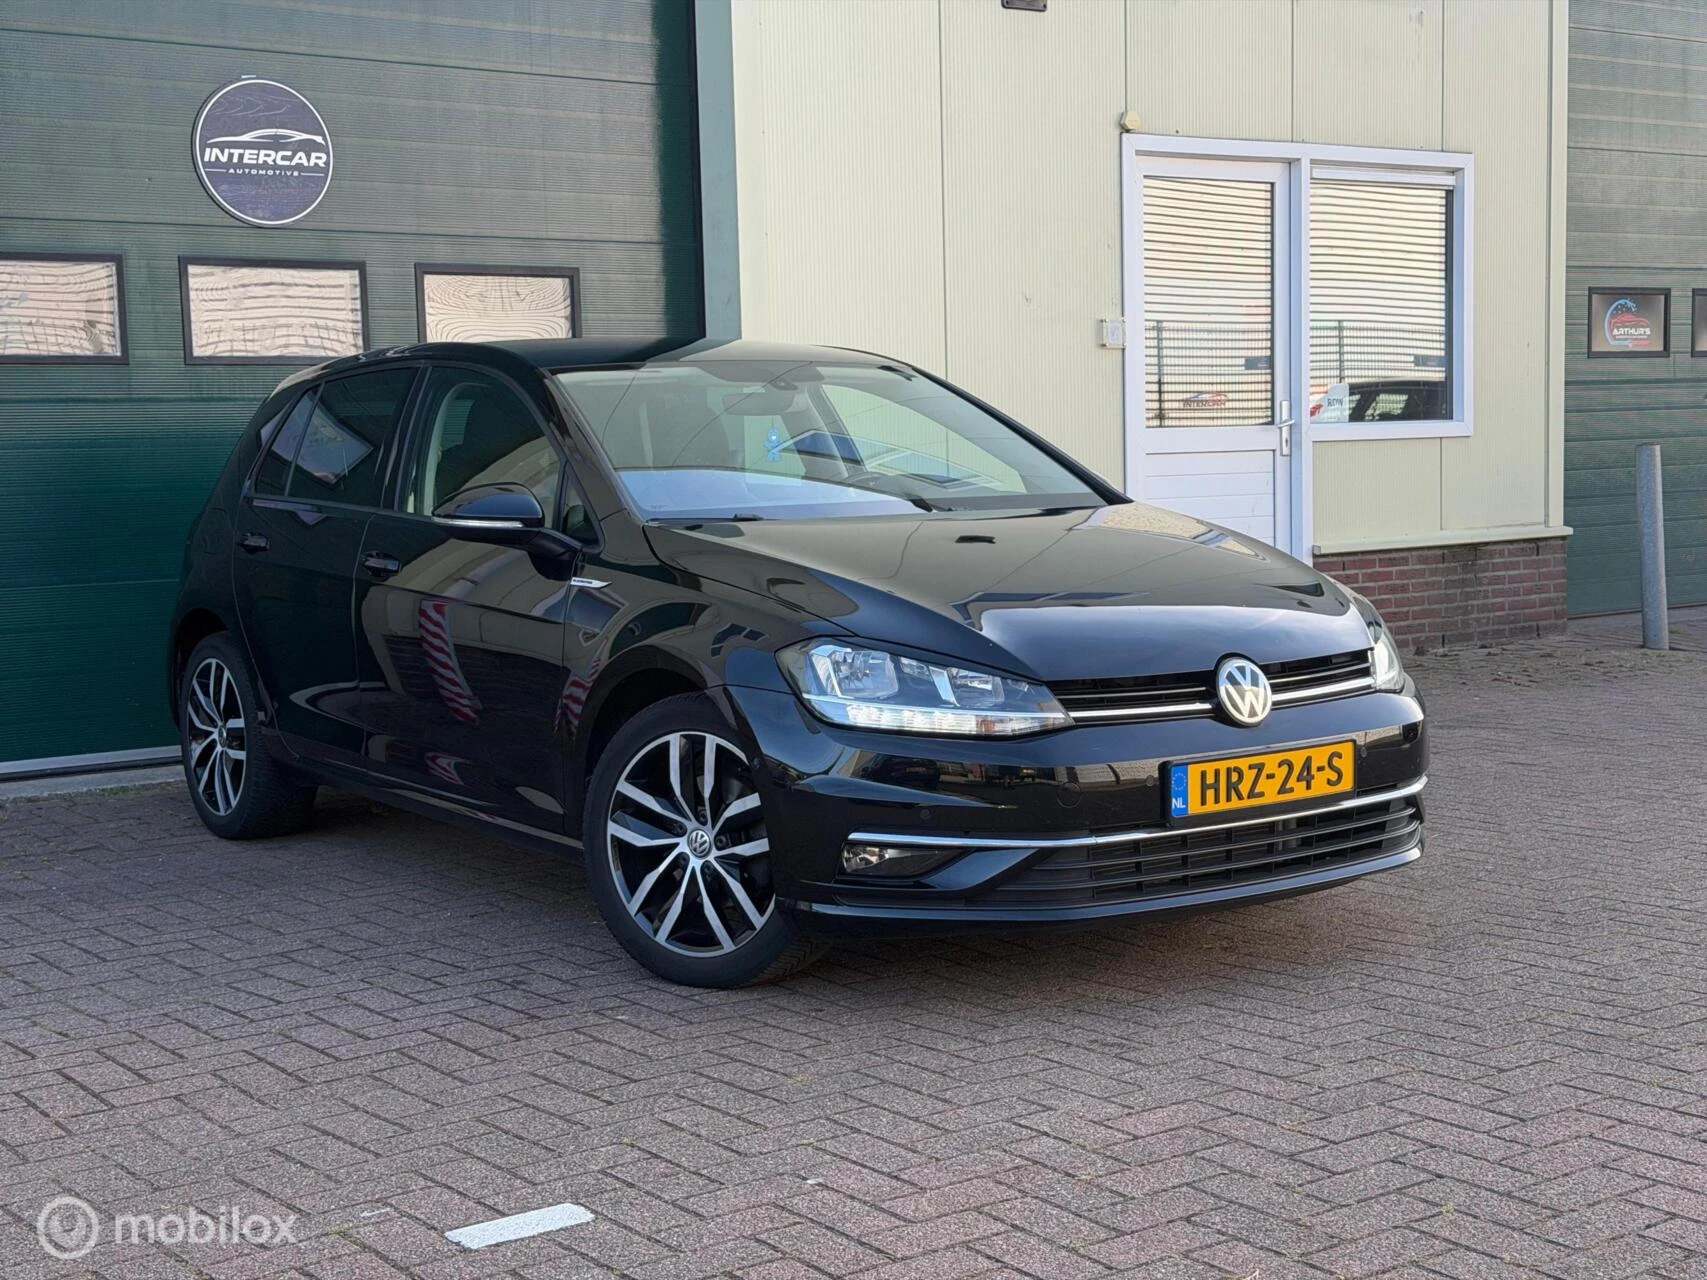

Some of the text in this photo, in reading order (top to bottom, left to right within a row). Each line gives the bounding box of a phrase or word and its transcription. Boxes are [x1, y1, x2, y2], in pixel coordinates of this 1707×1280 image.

[204, 147, 327, 168] INTERCAR
[228, 168, 298, 177] AUTOMOTIVE
[1200, 750, 1343, 807] HRZ-24-S
[1171, 797, 1186, 809] NL
